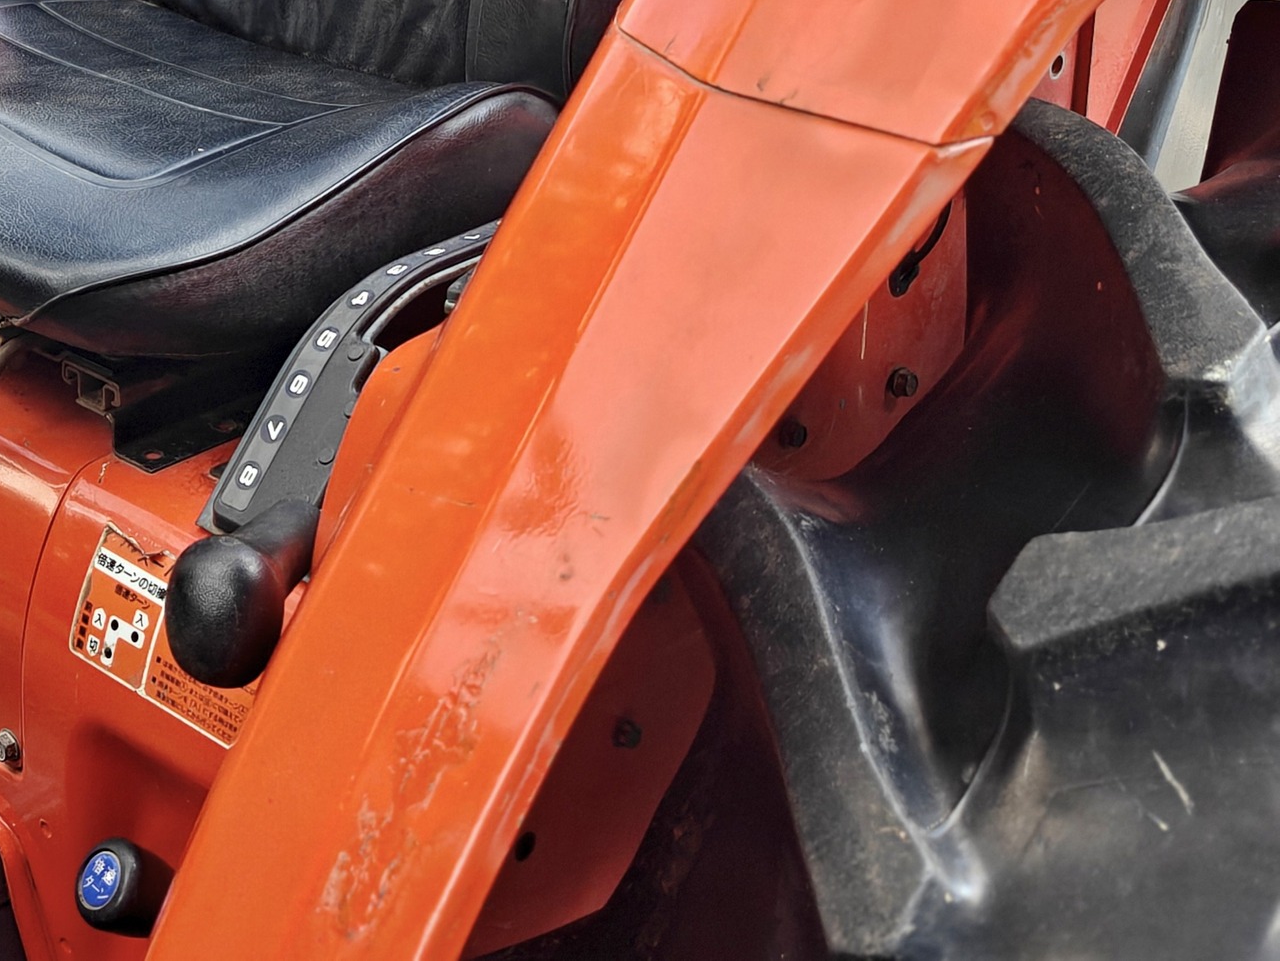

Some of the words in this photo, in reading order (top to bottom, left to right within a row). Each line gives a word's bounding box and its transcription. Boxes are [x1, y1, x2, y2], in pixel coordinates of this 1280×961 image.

[351, 291, 369, 305] 4
[316, 329, 337, 348] 5
[267, 420, 284, 441] 7
[239, 466, 258, 486] 8
[94, 613, 103, 627] 入
[135, 612, 145, 627] 入
